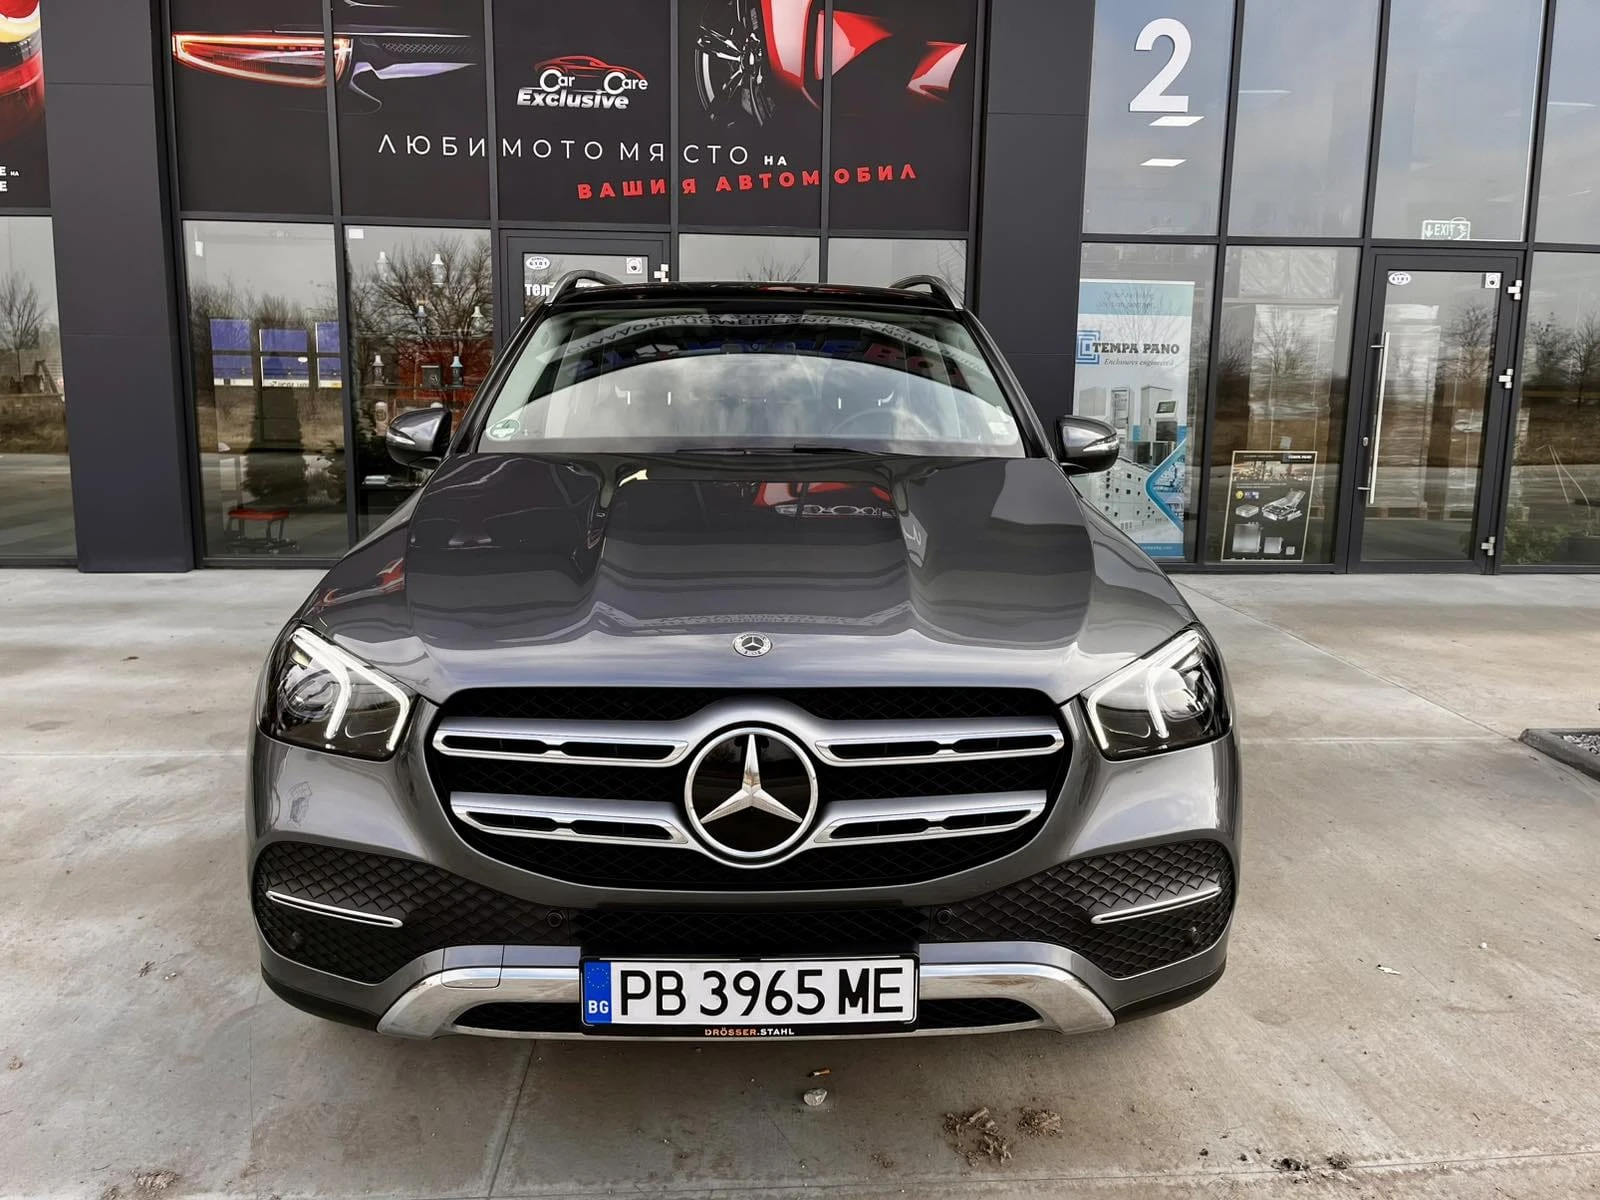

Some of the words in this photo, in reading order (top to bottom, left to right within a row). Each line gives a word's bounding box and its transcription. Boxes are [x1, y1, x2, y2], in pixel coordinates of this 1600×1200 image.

[1129, 18, 1192, 113] 2
[539, 69, 576, 92] Car
[604, 71, 649, 95] Care
[516, 89, 630, 110] Exclusive
[378, 134, 603, 160] ЛЮБИМОТО
[620, 142, 749, 165] МЯСТО
[764, 155, 787, 166] НА
[577, 178, 697, 199] ВАШИЯ
[715, 163, 917, 193] АВТОМОБИЛ
[1434, 224, 1456, 236] EXIT
[1092, 343, 1138, 354] TEMPA
[1143, 343, 1180, 355] PANO
[588, 1001, 609, 1014] BG
[620, 970, 687, 1016] PB
[699, 970, 826, 1017] 3965
[838, 967, 903, 1015] ME
[704, 1027, 795, 1036] DRÖSSER.STAHL
